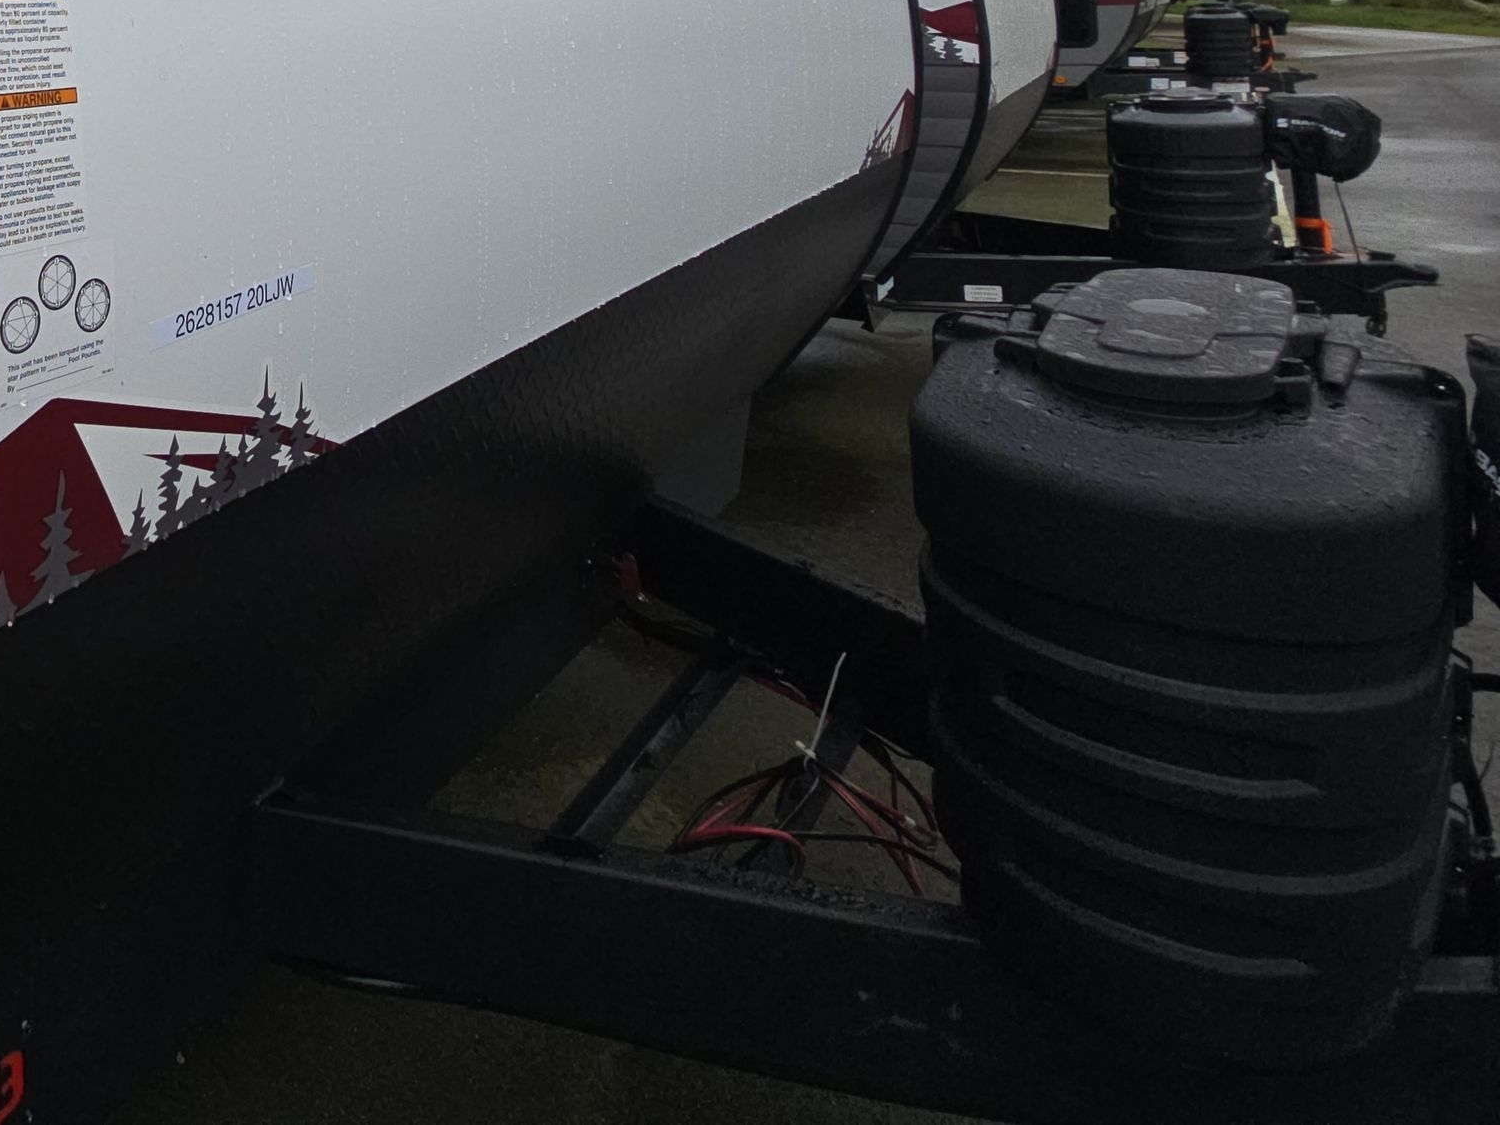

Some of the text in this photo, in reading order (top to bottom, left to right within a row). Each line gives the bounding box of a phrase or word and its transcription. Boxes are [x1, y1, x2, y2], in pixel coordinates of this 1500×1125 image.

[5, 27, 41, 35] approximately
[21, 47, 42, 55] propane
[43, 45, 72, 54] container(s)
[18, 56, 49, 64] uncontrolled
[12, 91, 61, 107] WARNING
[1, 114, 21, 122] propane
[23, 112, 38, 121] piping
[39, 111, 56, 119] system
[8, 131, 29, 139] connect
[11, 139, 33, 148] Securely
[6, 162, 24, 170] turning
[54, 155, 70, 163] except
[24, 168, 44, 177] cylinder
[4, 180, 25, 189] propane
[26, 177, 41, 186] piping
[52, 171, 80, 180] connections
[1, 189, 27, 198] appliances
[36, 184, 55, 192] leakage
[67, 180, 80, 188] soapy
[16, 196, 33, 204] bubble
[23, 207, 45, 217] products
[56, 201, 74, 209] contain
[27, 215, 46, 224] chlorine
[70, 216, 84, 224] which
[12, 236, 26, 245] result
[33, 232, 47, 241] death
[175, 273, 294, 338] 2628157 20LJW
[1476, 449, 1500, 497] BA
